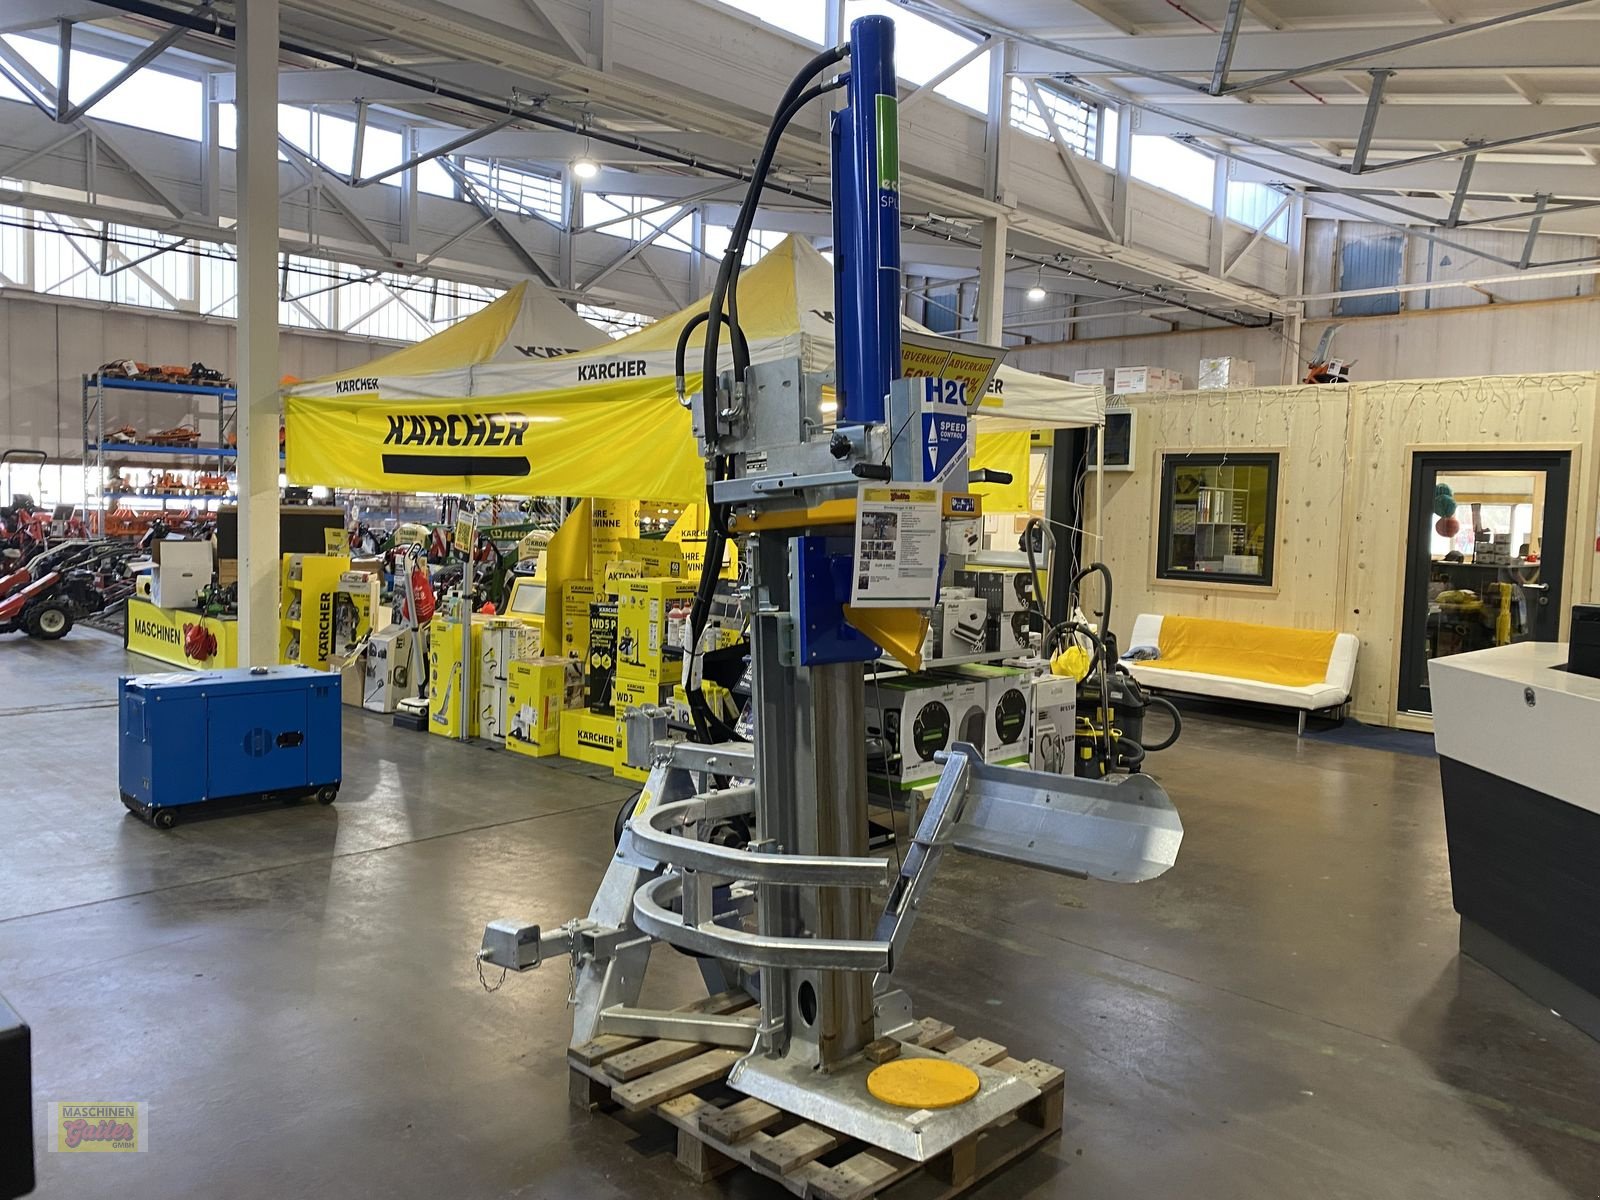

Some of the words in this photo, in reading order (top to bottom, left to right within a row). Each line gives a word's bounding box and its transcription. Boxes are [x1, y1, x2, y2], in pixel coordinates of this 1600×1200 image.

[882, 179, 898, 191] ec
[578, 360, 647, 381] KÄRCHER
[948, 358, 990, 373] ABVERKAUF
[335, 378, 379, 393] KÄRCHER
[383, 412, 530, 447] KÄRCHER
[940, 421, 966, 432] SPEED
[940, 430, 963, 440] CONTROL
[503, 530, 527, 539] KRO
[134, 618, 180, 646] MASCHINEN
[319, 592, 331, 662] KÄRCHER
[577, 729, 615, 745] KÄRCHER
